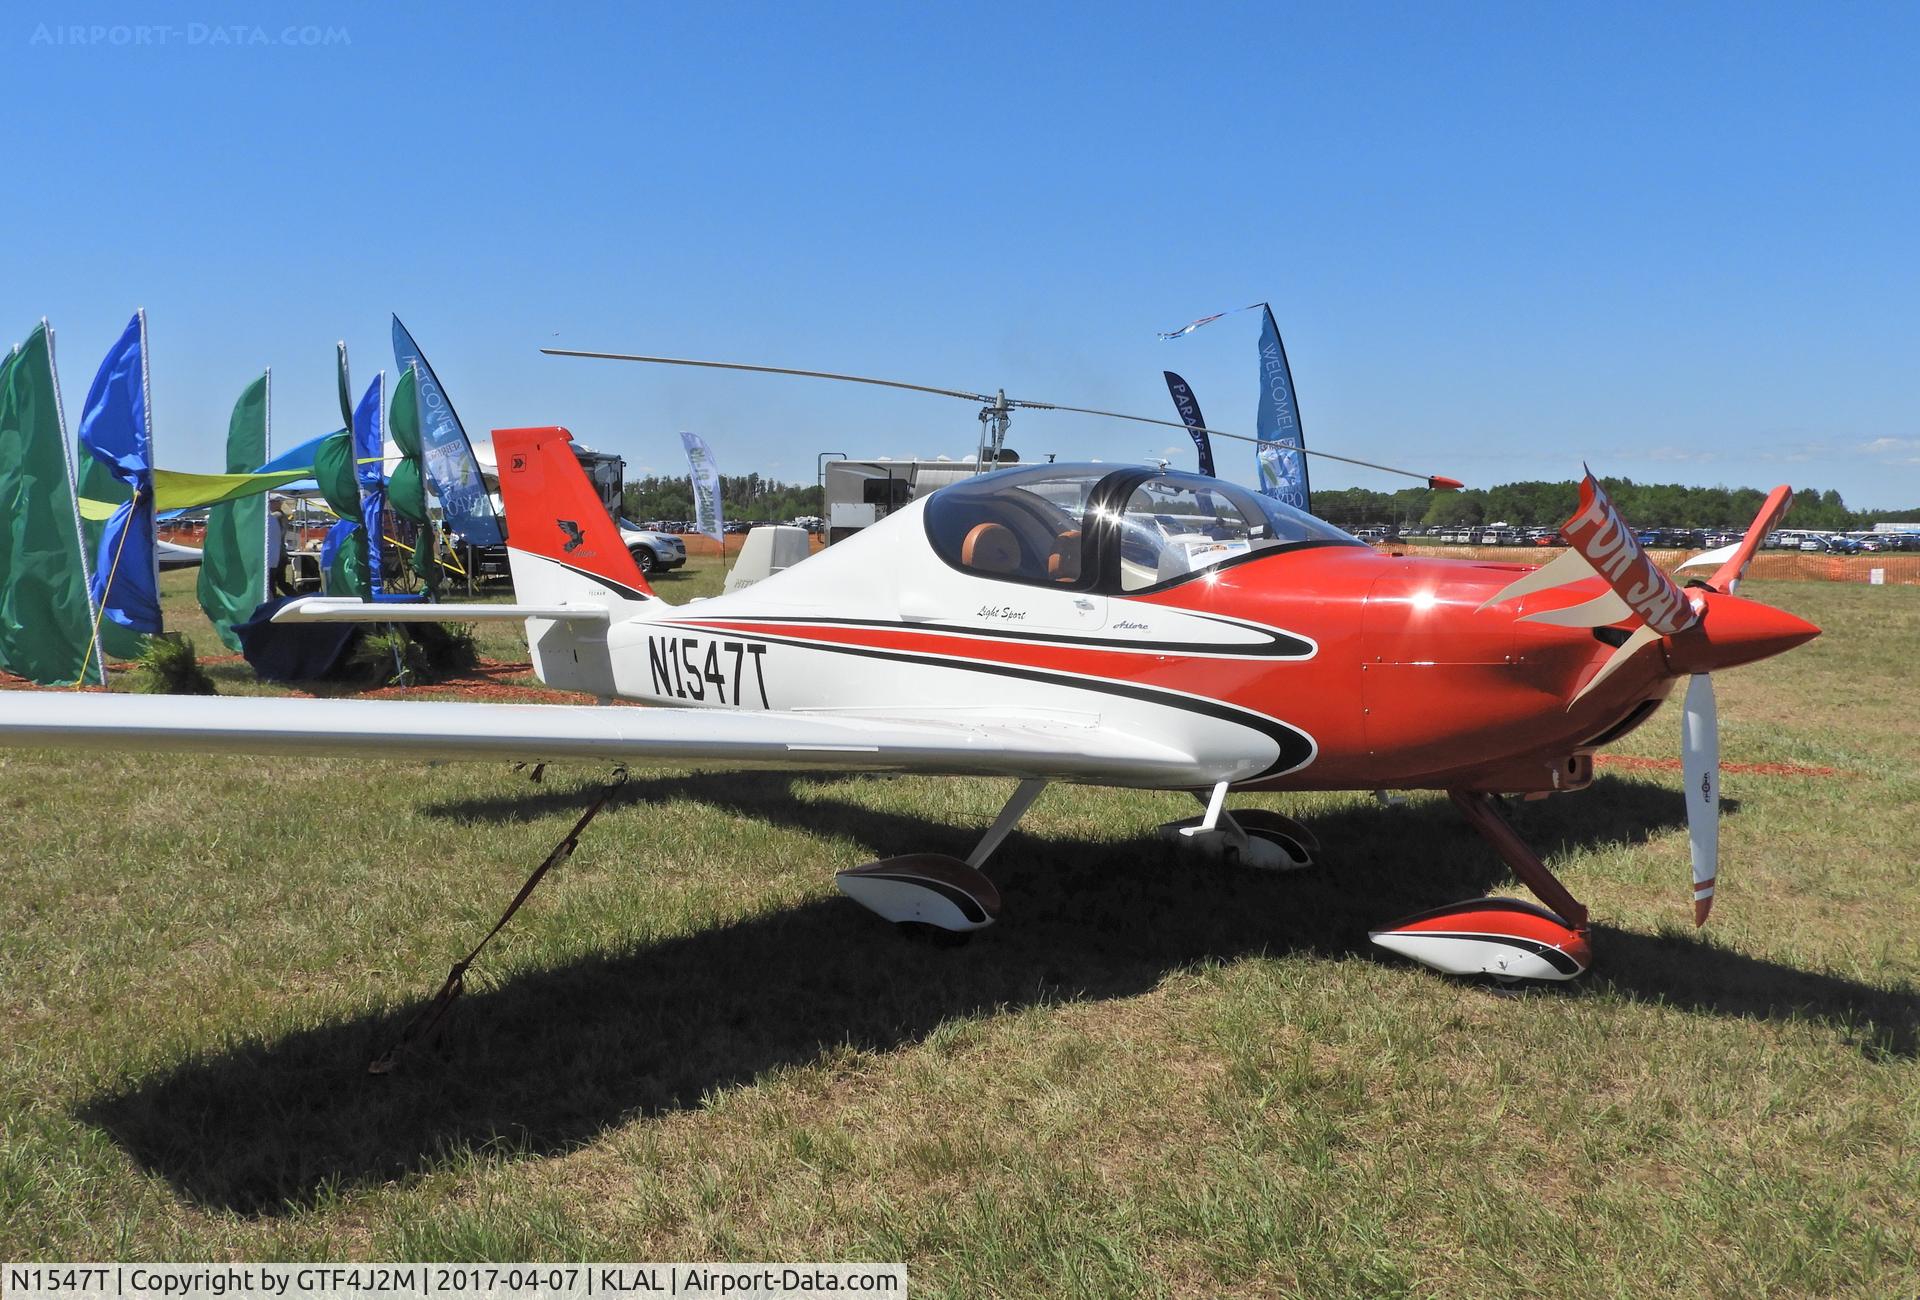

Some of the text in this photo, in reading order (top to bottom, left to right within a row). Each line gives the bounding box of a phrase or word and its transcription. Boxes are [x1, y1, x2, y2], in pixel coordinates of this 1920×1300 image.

[1261, 341, 1294, 431] WELCOME!
[1564, 486, 1639, 583] FOR
[976, 605, 1027, 622] Light Sport
[648, 636, 770, 710] N1547T
